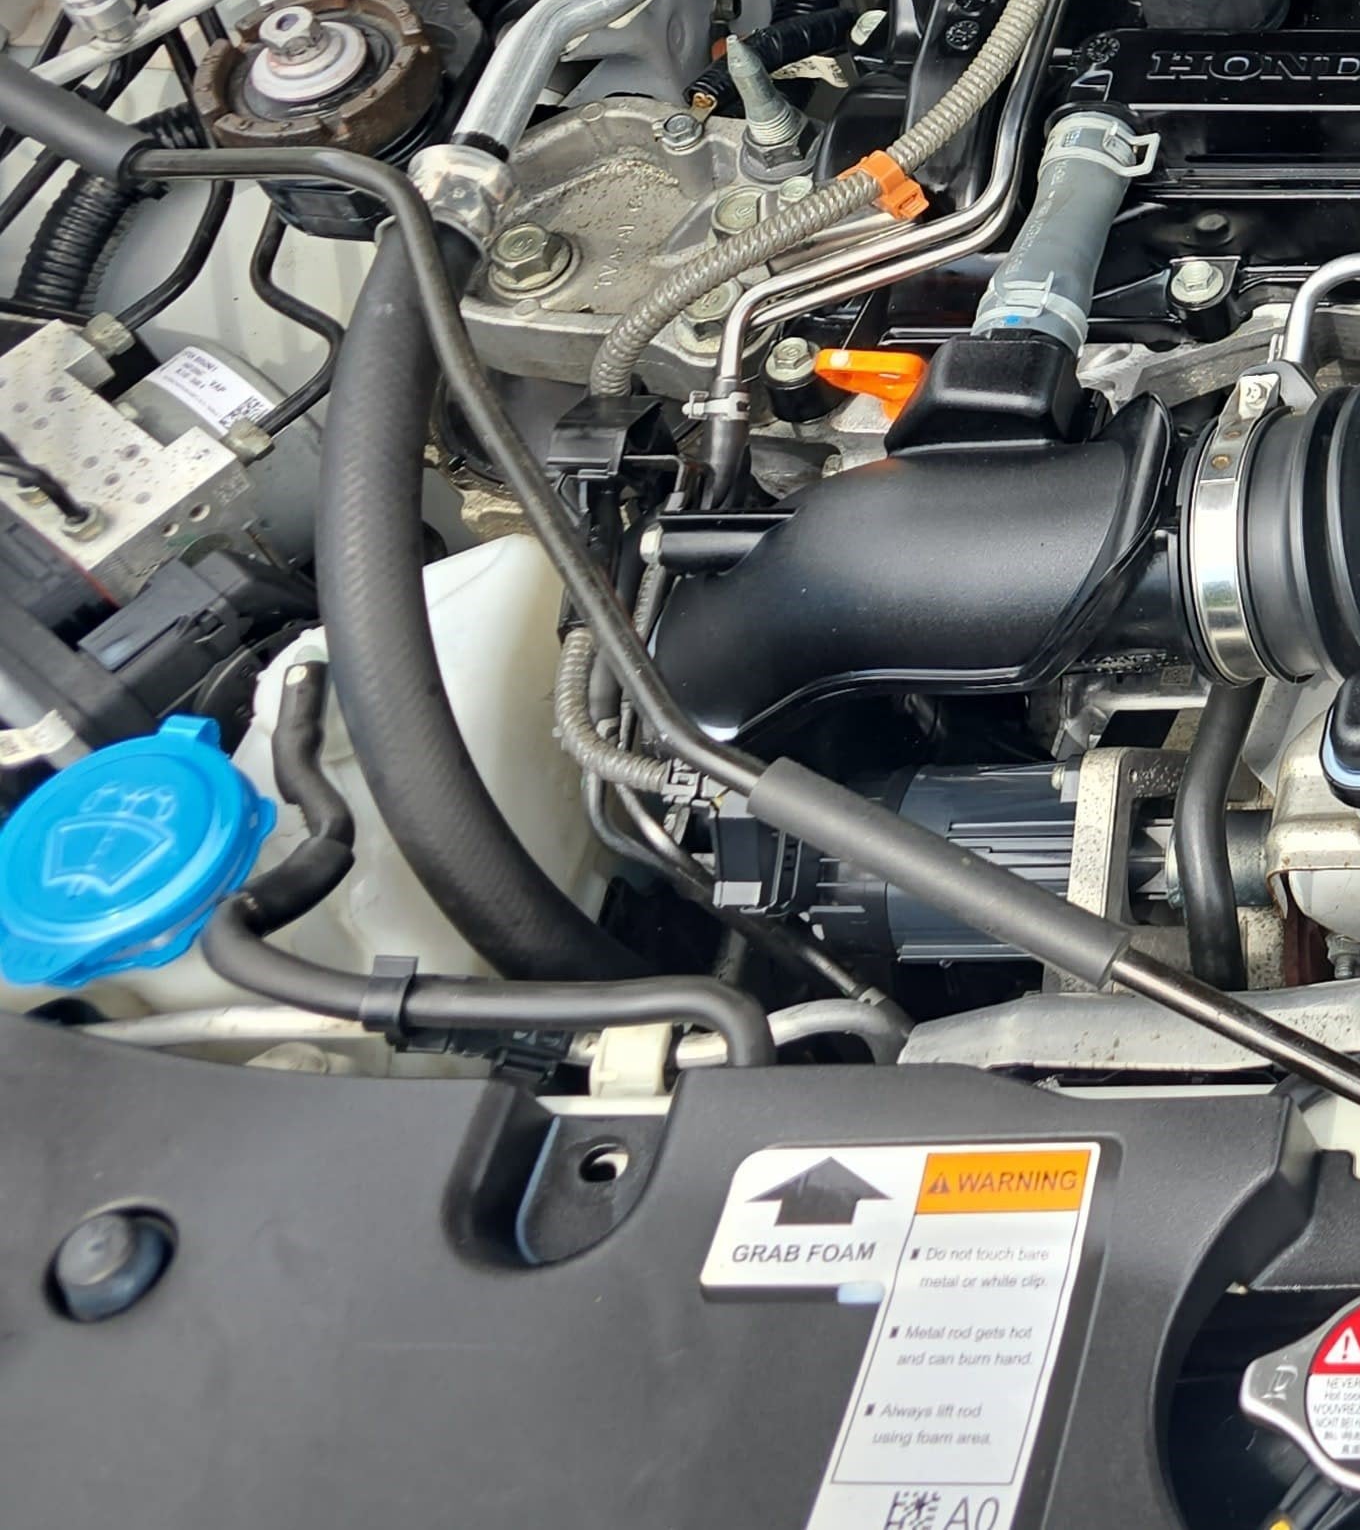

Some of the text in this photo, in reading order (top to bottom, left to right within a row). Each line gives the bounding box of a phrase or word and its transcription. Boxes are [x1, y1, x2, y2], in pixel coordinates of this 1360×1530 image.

[956, 1170, 1079, 1192] WARNING
[731, 1242, 878, 1263] GRAB FOAM
[925, 1246, 1050, 1261] Do not touch bare
[918, 1274, 960, 1288] metal
[961, 1277, 978, 1288] or
[980, 1274, 1018, 1288] white
[904, 1325, 1033, 1342] Metal rod gets hot
[896, 1351, 926, 1366] and
[928, 1354, 955, 1366] can
[957, 1351, 993, 1366] burn
[880, 1403, 984, 1421] Always lift rod
[872, 1432, 913, 1448] using
[916, 1430, 954, 1445] foam
